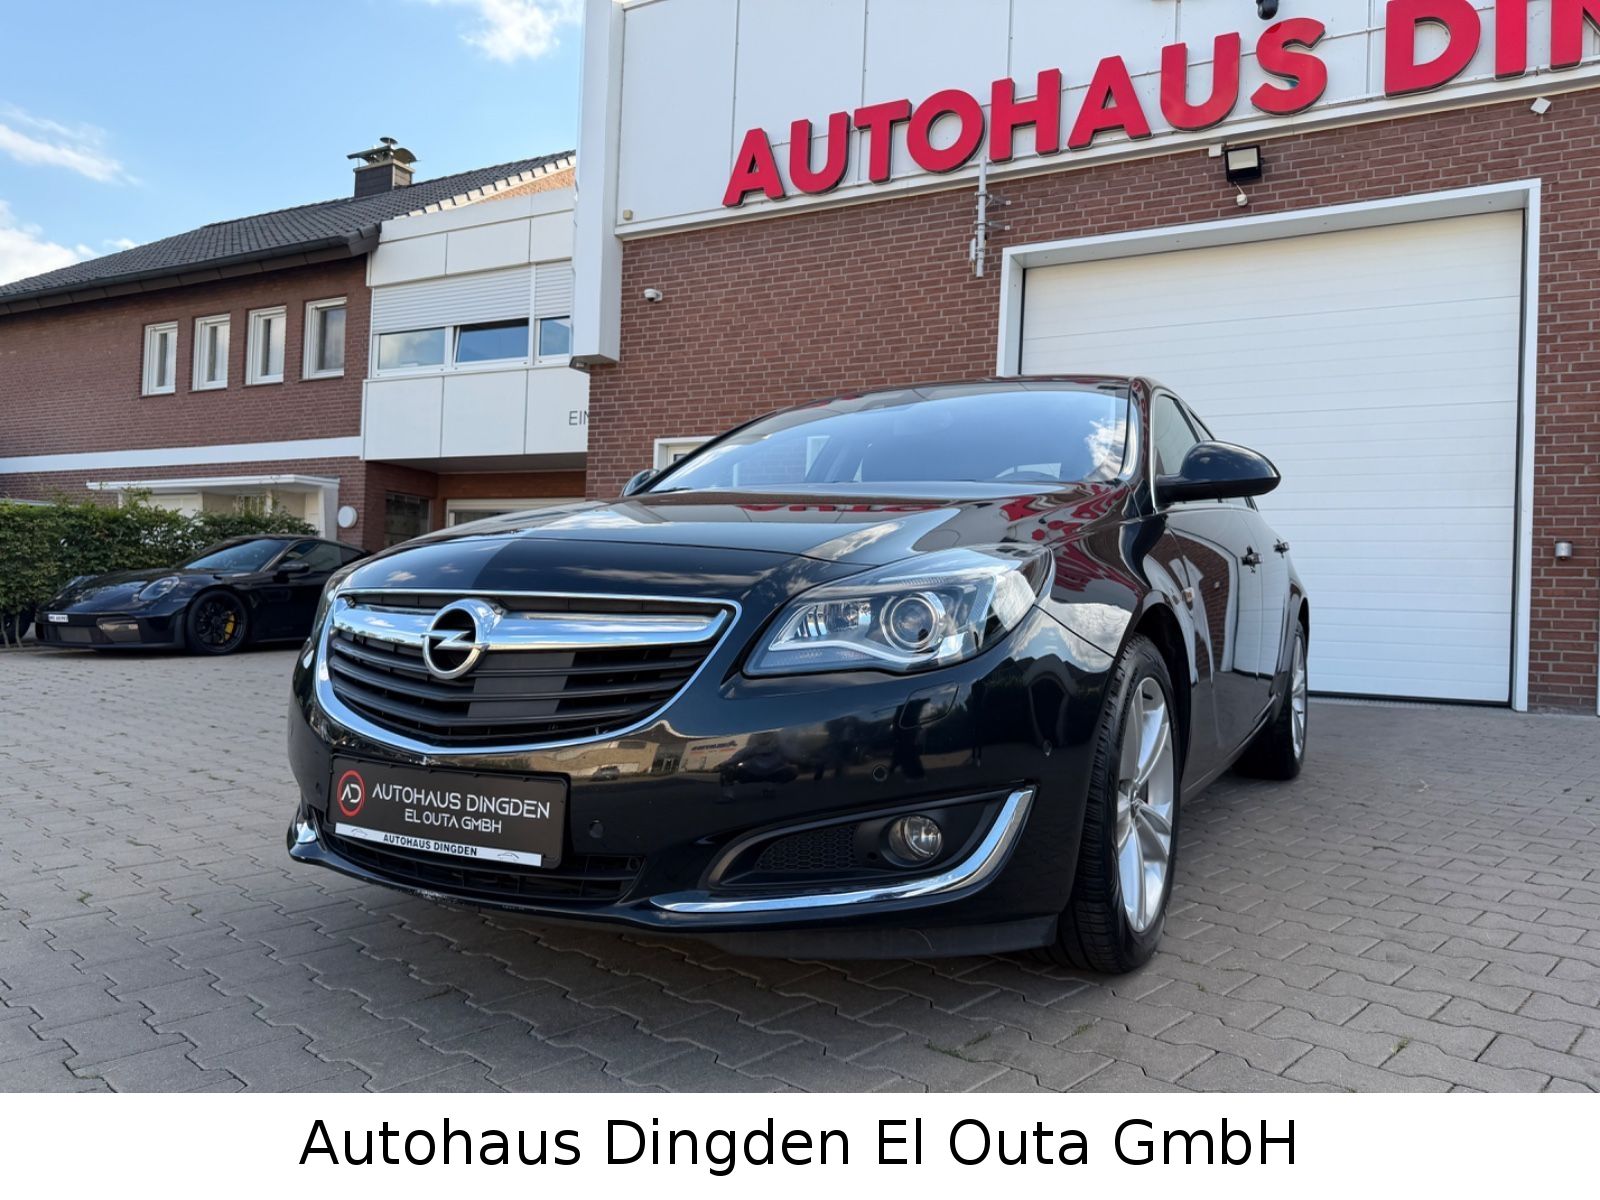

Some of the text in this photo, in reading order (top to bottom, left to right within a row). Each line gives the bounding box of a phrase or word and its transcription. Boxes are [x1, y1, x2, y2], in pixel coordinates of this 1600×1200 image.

[723, 17, 1328, 207] AUTOHAUS
[372, 782, 551, 820] AUTOHAUS DINGDEN
[404, 808, 502, 834] EL OUTA GMBH
[383, 833, 478, 857] AUTOHAUS DINGDEN
